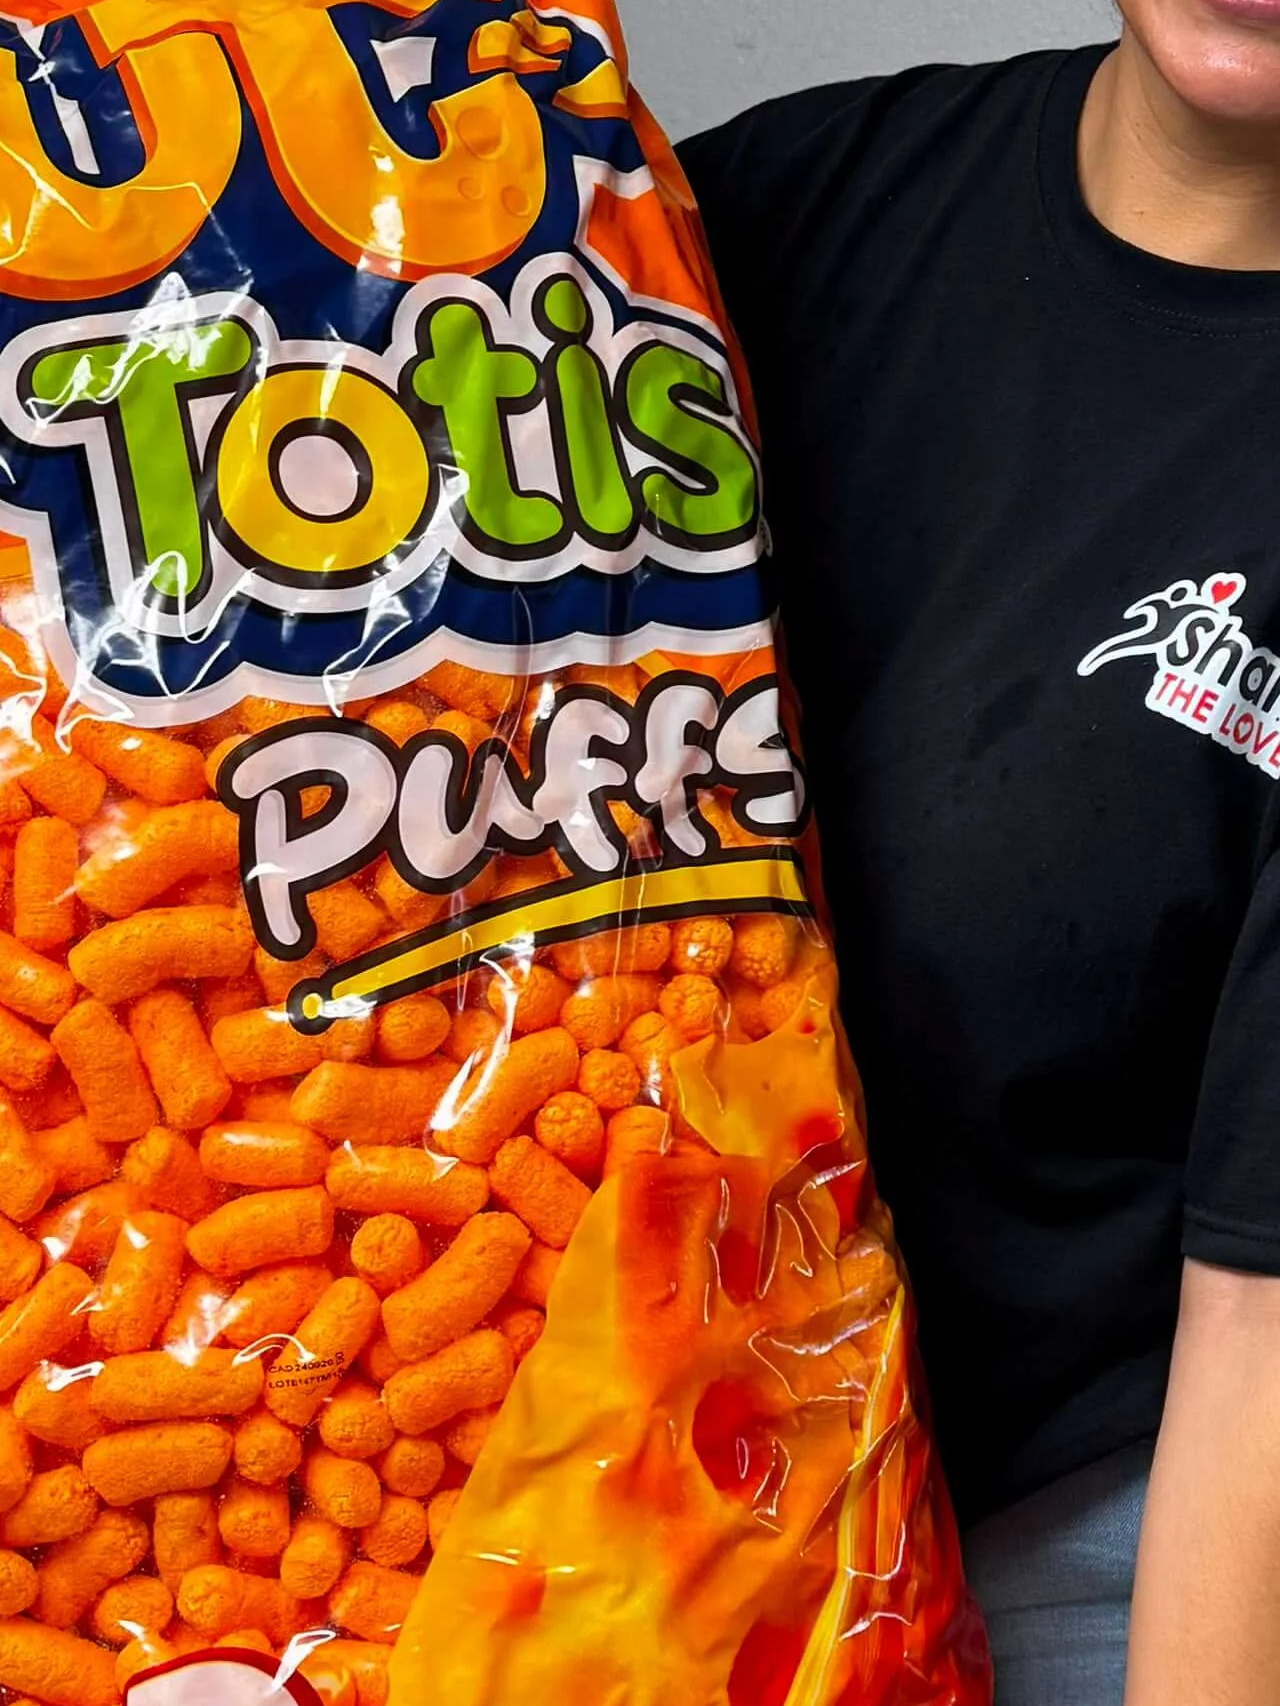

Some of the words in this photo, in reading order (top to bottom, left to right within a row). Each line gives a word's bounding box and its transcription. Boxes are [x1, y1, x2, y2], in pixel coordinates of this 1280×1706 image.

[24, 273, 762, 611] Totis
[226, 671, 806, 960] Puffs
[1154, 673, 1220, 725] THE
